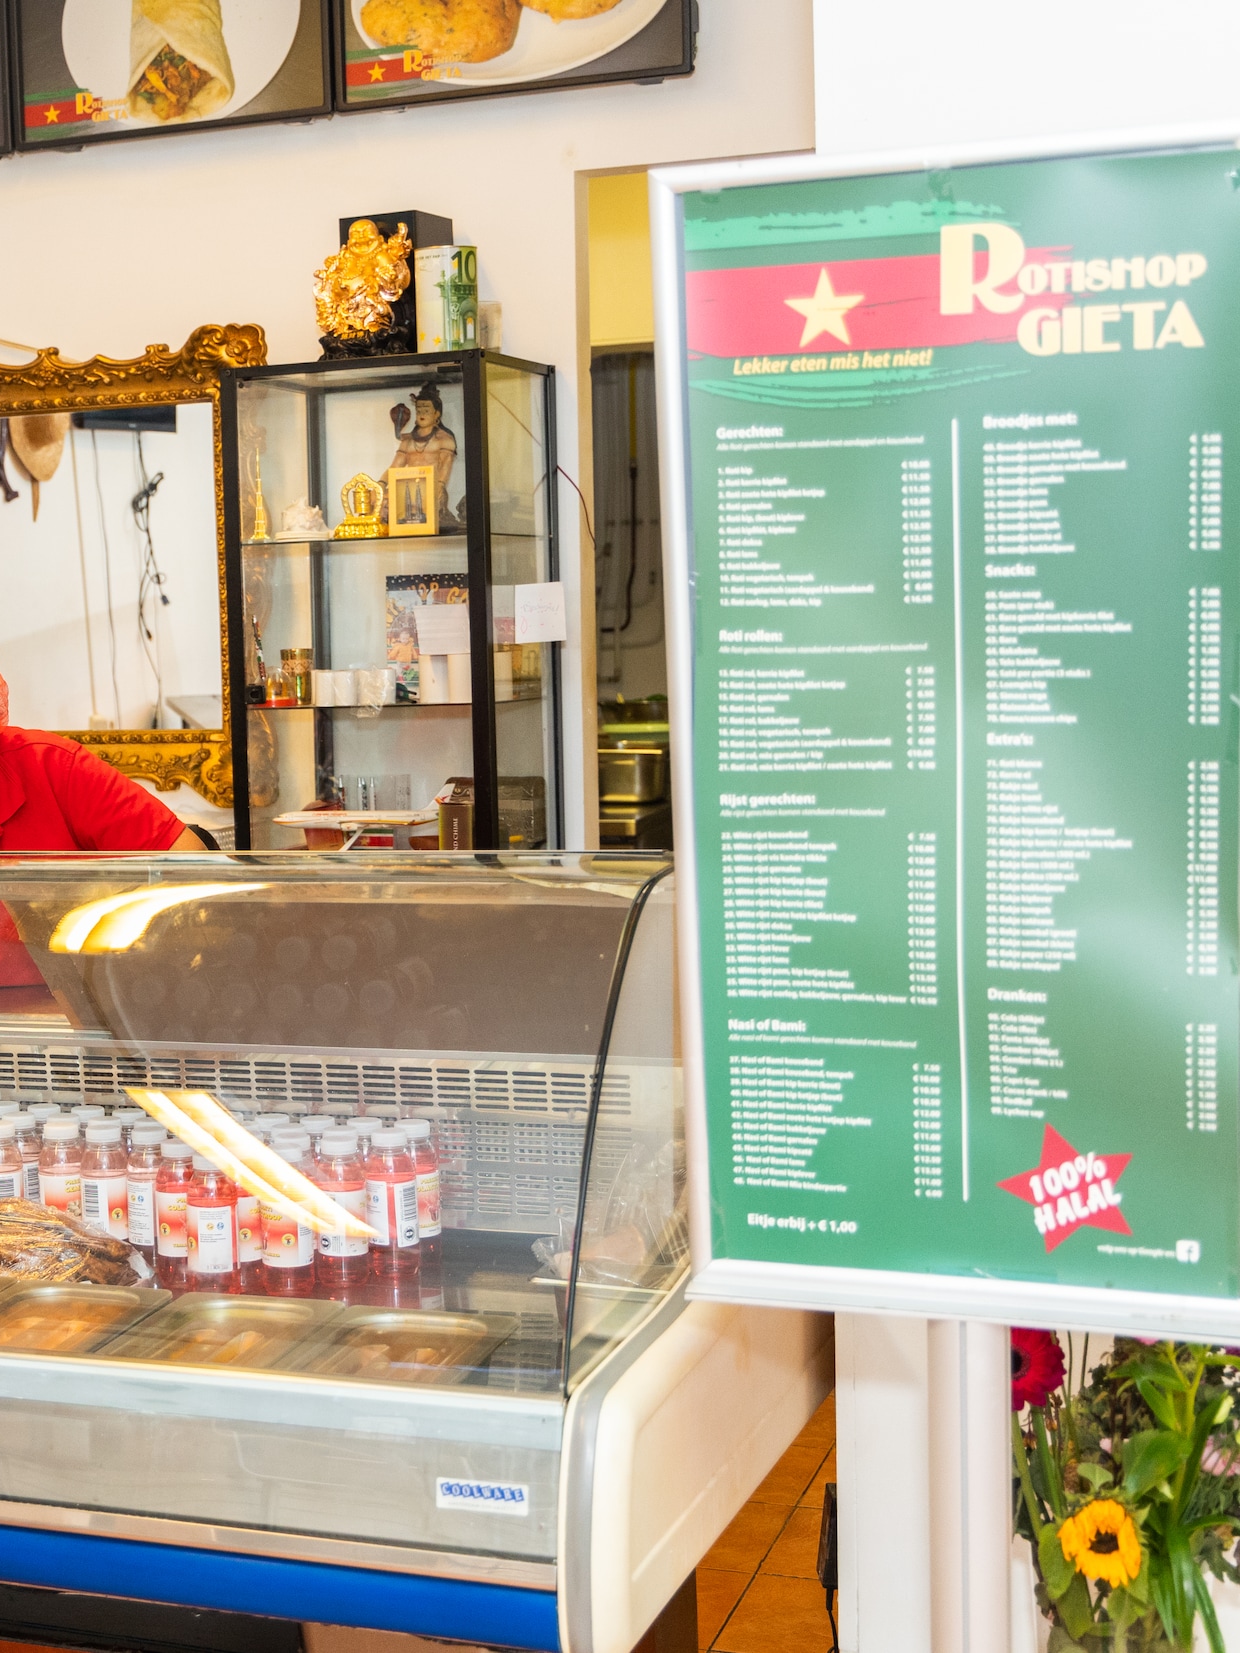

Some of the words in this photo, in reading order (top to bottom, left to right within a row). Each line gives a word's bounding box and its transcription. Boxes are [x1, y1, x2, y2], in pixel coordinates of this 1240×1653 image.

[451, 250, 476, 283] 10
[1017, 299, 1205, 356] GIETA
[733, 357, 788, 375] Lekker
[790, 356, 828, 373] eten
[830, 353, 859, 371] mis
[862, 350, 890, 369] het
[892, 348, 934, 367] niet!
[983, 414, 1044, 429] Broodjes
[1045, 412, 1077, 426] met:
[716, 425, 784, 439] Gerechten:
[985, 563, 1035, 577] Snacks:
[719, 630, 742, 642] Roti
[744, 629, 782, 642] rollen:
[987, 732, 1033, 746] Extra's:
[720, 794, 747, 808] Rijst
[749, 793, 816, 808] gerechten:
[988, 988, 1046, 1002] Dranken:
[728, 1019, 754, 1030] Nasi
[757, 1019, 770, 1031] of
[772, 1020, 806, 1032] Bami:
[1029, 1151, 1107, 1203] 100%
[1033, 1178, 1122, 1234] HALAL
[747, 1213, 775, 1228] Eitje
[777, 1216, 805, 1232] erbij
[818, 1220, 827, 1231] €
[830, 1220, 857, 1233] 1,00
[440, 1482, 525, 1502] COOLWARE
